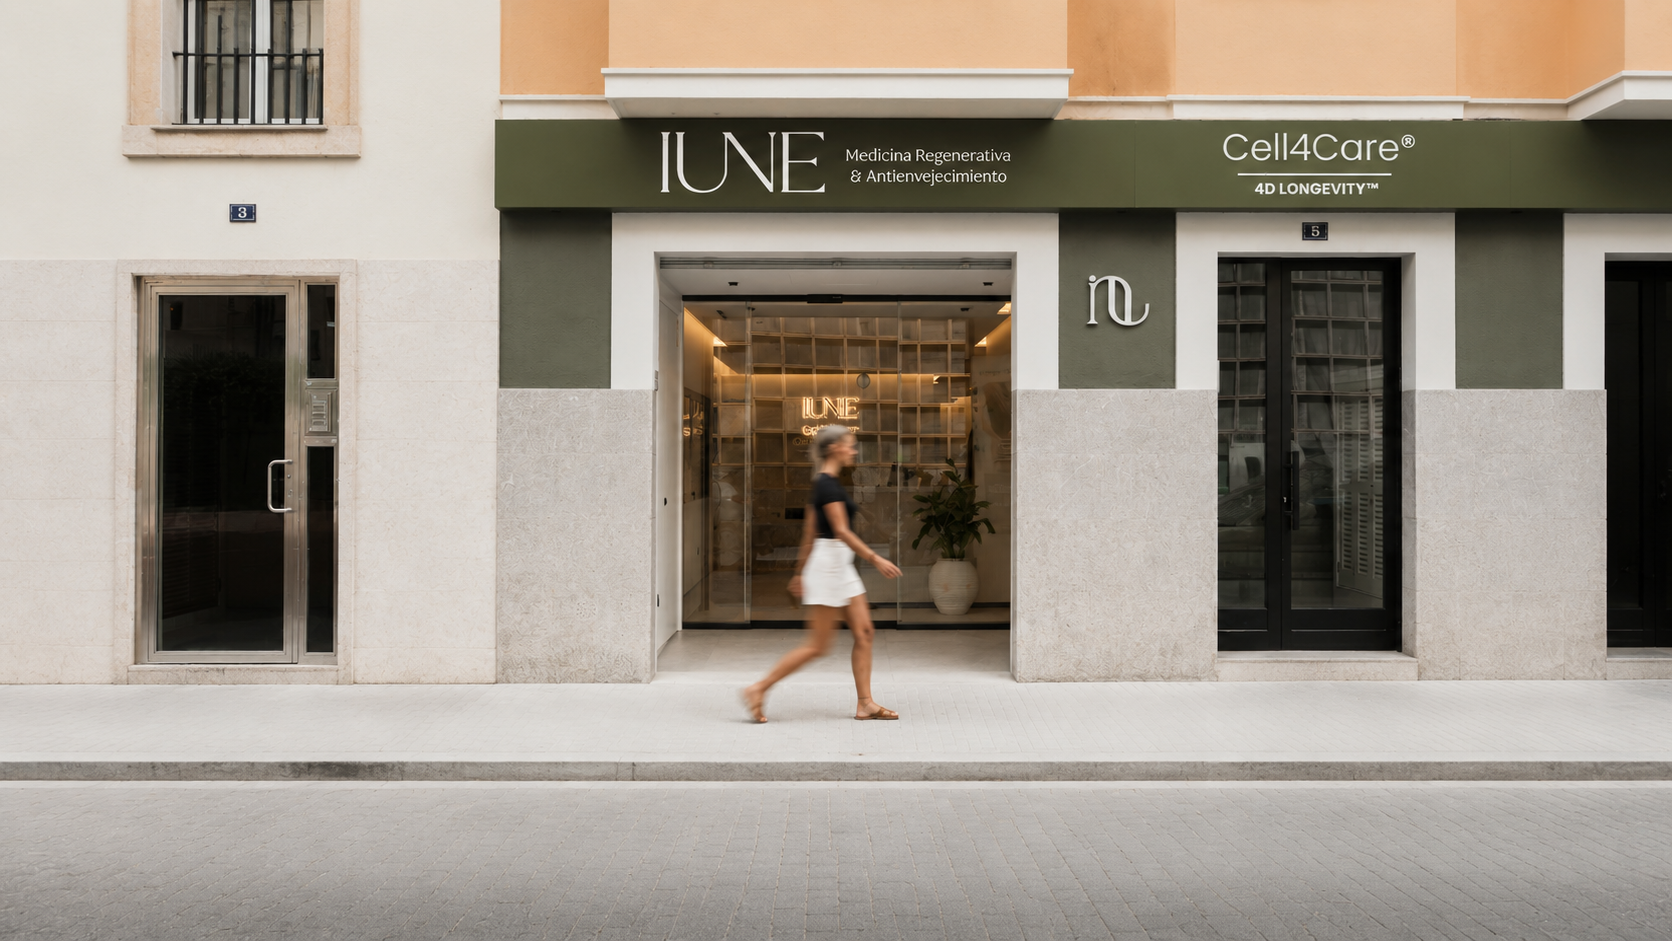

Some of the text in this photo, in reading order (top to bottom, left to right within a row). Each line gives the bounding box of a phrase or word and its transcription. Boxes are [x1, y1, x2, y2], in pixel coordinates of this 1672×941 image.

[660, 131, 826, 194] IUNE
[845, 148, 1012, 166] Medicina Regenerativa
[850, 168, 1007, 187] & Antienvejecimiento
[1254, 182, 1276, 195] 4D
[237, 206, 248, 219] 3
[1311, 225, 1320, 237] 5
[802, 396, 860, 419] IUNE
